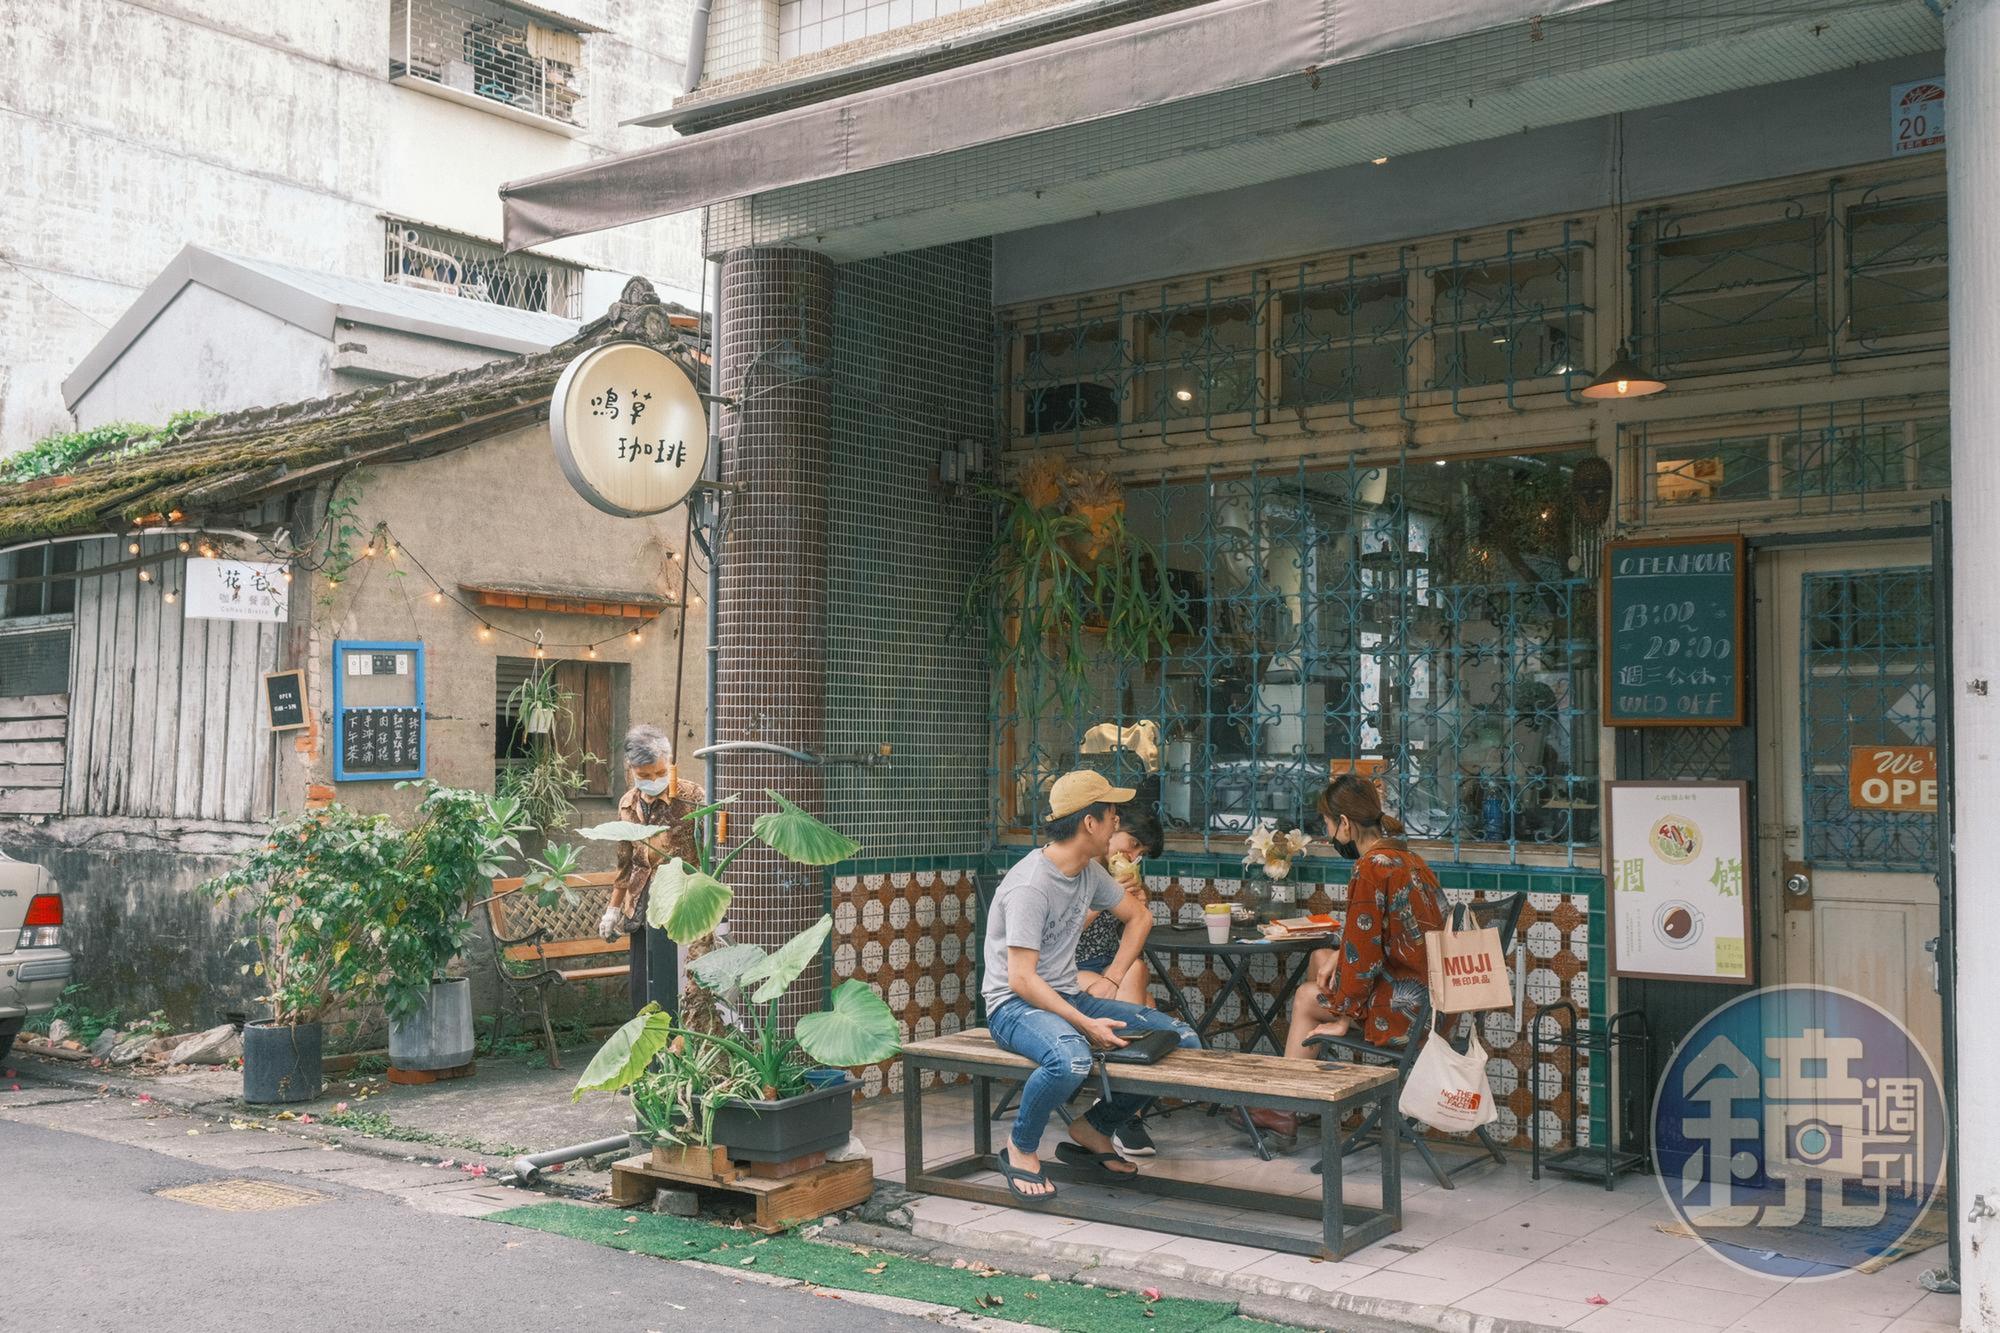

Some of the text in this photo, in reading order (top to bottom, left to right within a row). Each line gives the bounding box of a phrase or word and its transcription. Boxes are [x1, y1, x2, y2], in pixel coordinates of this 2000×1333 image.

[1899, 115, 1926, 140] 20
[591, 387, 652, 425] 鳴草
[219, 592, 241, 604] 咖
[1643, 635, 1732, 660] 20:00
[1618, 664, 1716, 687] 週三公休
[347, 716, 360, 763] 下午茶
[1872, 750, 1936, 775] We'
[1443, 952, 1492, 977] MUJI
[1451, 974, 1490, 987] 無印良品
[1440, 1089, 1472, 1103] NORTH
[1446, 1099, 1472, 1110] FACE
[1456, 1088, 1472, 1098] THE
